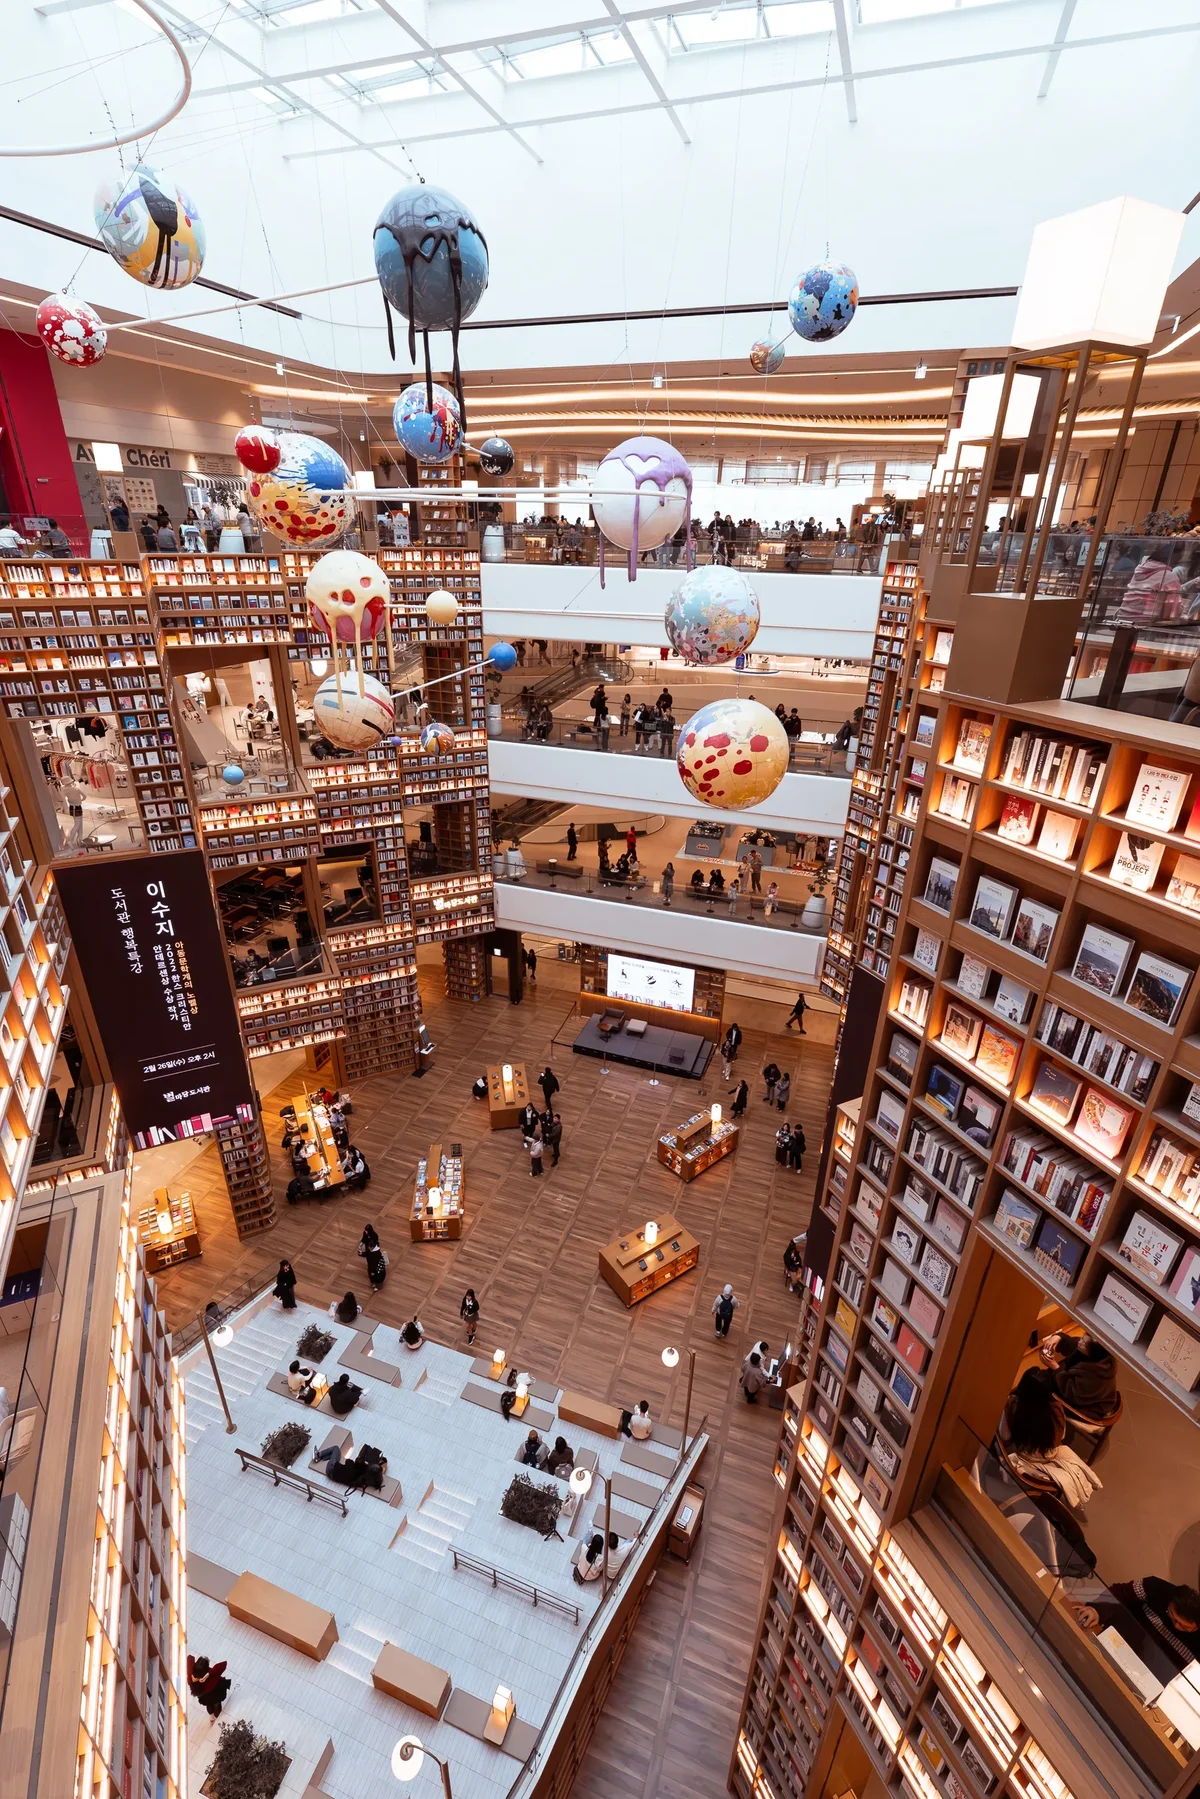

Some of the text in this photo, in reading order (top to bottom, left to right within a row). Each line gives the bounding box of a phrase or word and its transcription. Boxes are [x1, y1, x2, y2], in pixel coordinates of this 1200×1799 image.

[127, 448, 171, 468] Chéri
[1117, 860, 1149, 875] PROJECT
[111, 888, 143, 973] 도서관 행복특강
[147, 881, 174, 936] 이수지
[153, 944, 178, 1021] 안데르센상 수상 작가
[165, 944, 192, 1031] 2022 한스 크리스티안
[175, 941, 198, 1014] 아동문학계의 노벨상
[143, 1051, 215, 1073] 2월 26일(수) 오후 2시
[163, 1085, 211, 1103] 별마당도서관
